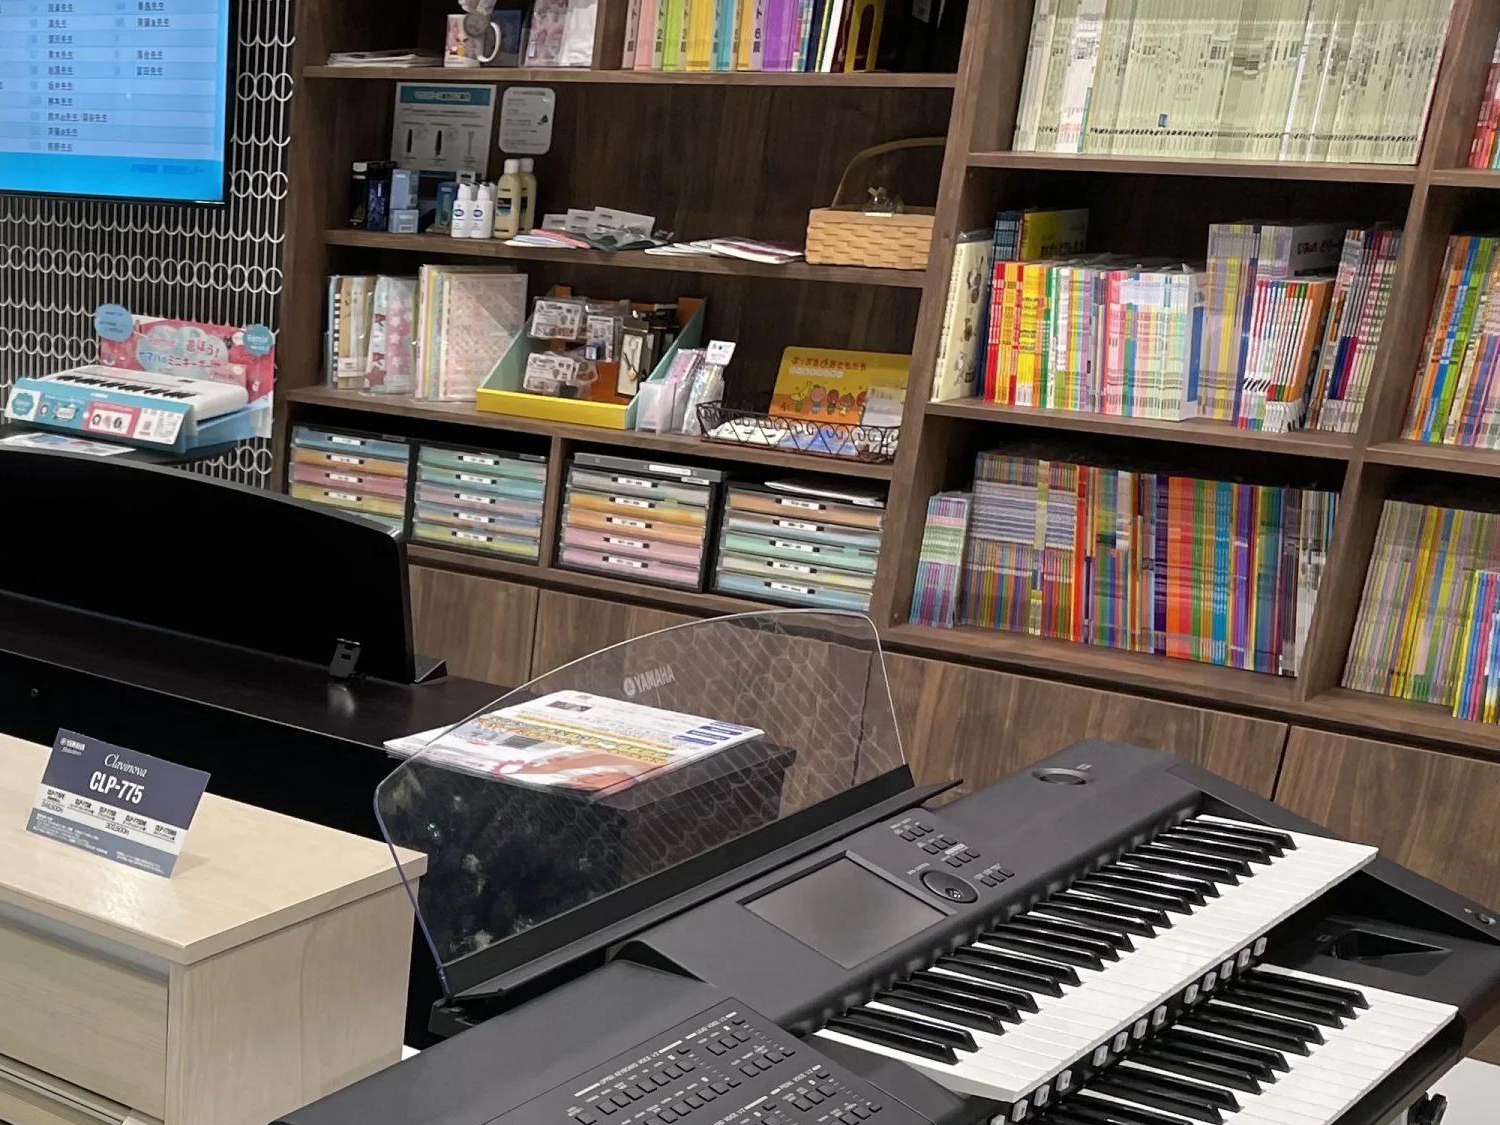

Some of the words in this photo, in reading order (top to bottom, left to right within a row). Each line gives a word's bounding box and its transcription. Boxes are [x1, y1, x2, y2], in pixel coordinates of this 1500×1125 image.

[634, 664, 676, 693] YAMAHA
[104, 753, 148, 778] Clavinova
[89, 771, 145, 804] CLP-775
